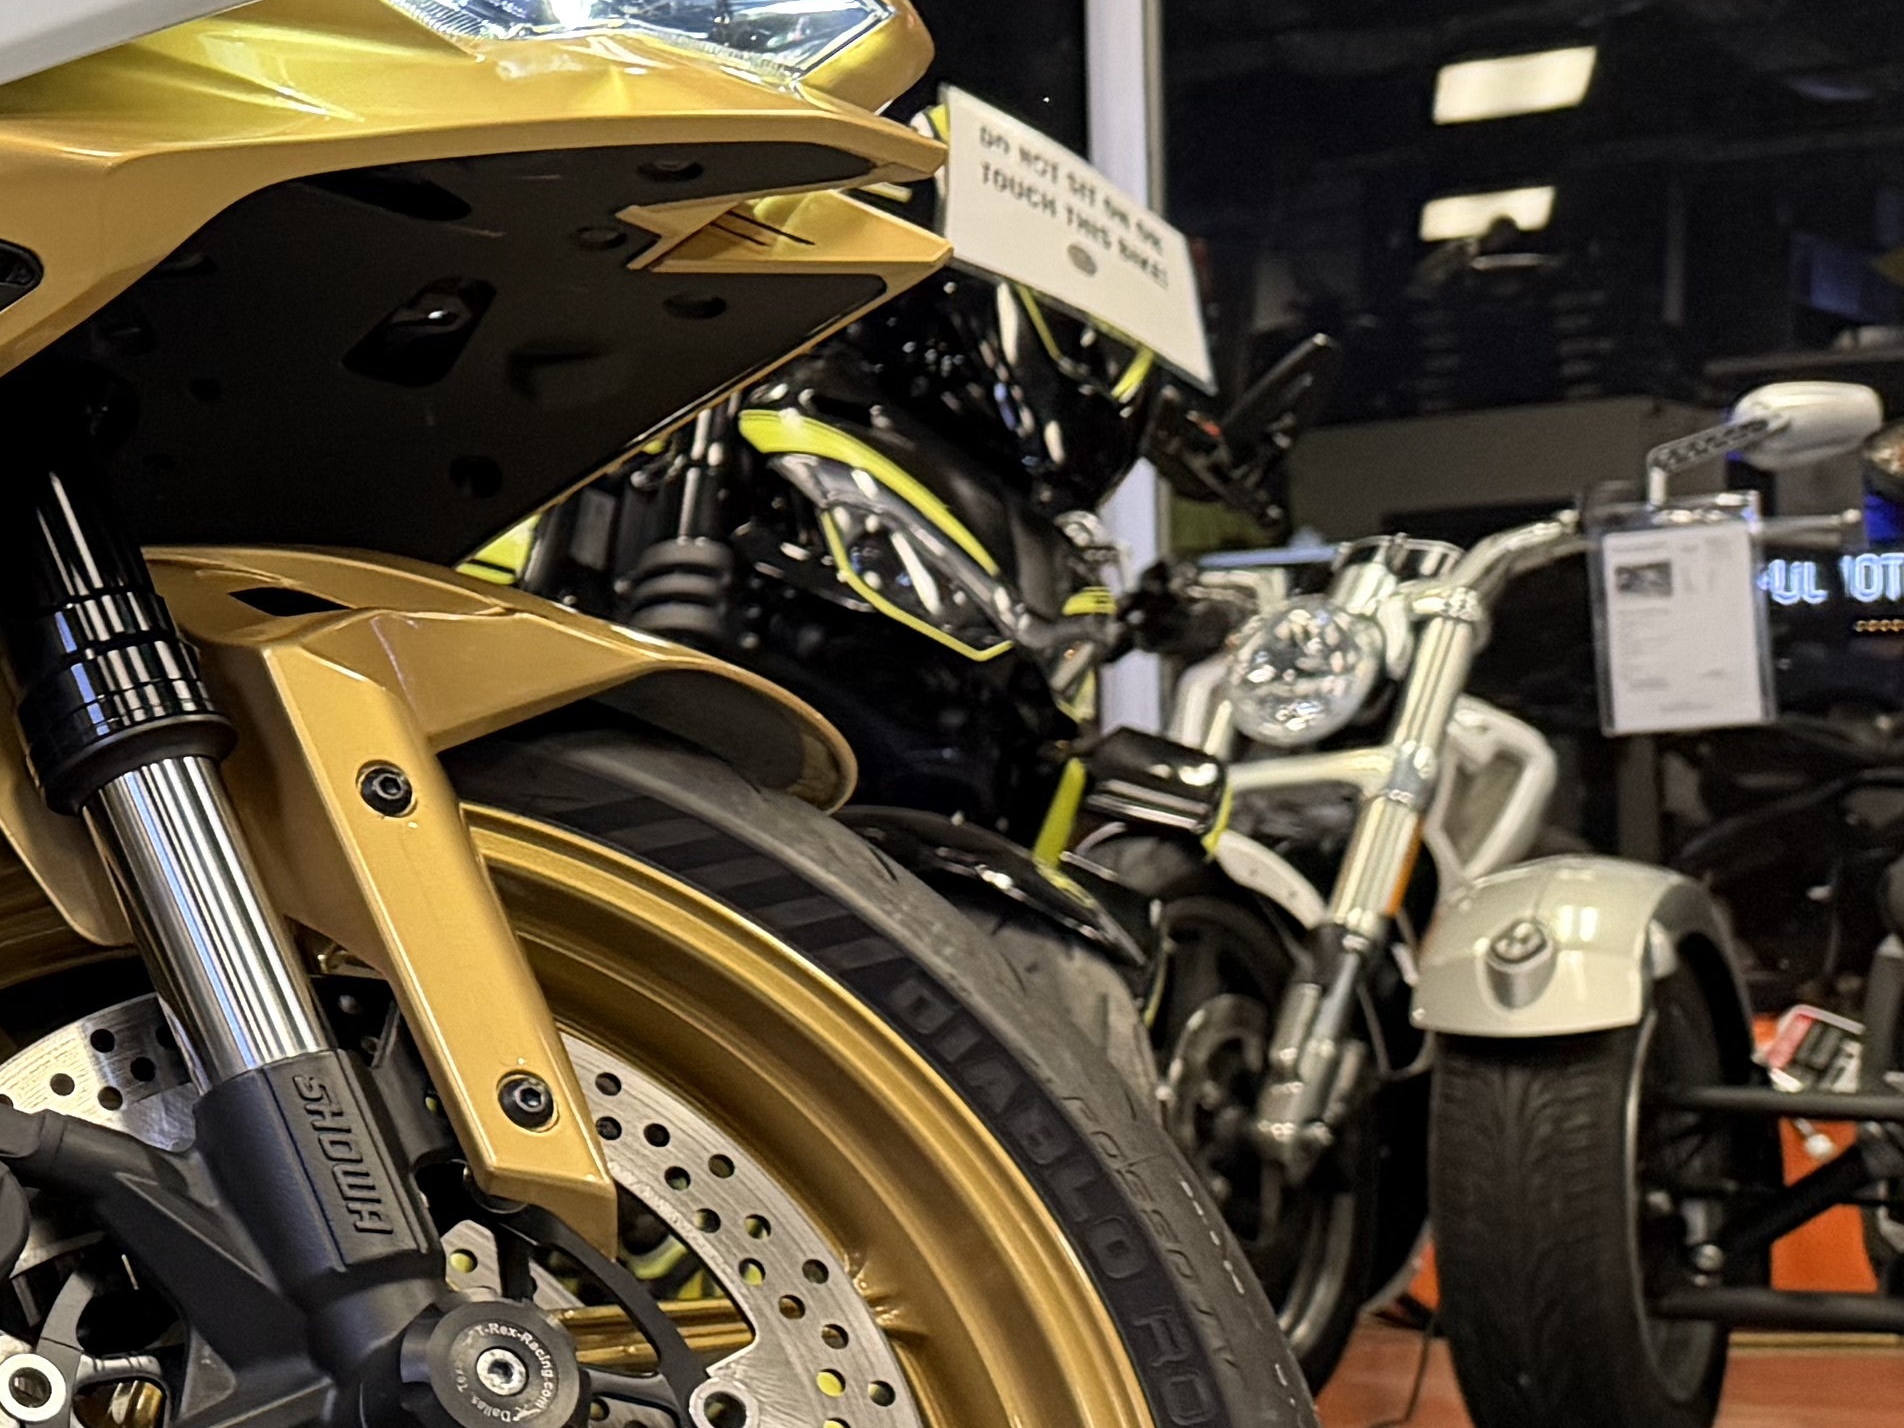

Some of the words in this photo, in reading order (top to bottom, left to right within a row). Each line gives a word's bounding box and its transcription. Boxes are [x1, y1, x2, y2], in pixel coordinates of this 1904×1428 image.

[980, 161, 1057, 217] TOUCH
[1019, 146, 1059, 183] NOT
[292, 1074, 394, 1235] SHOWA
[894, 977, 1149, 1278] DIABLO
